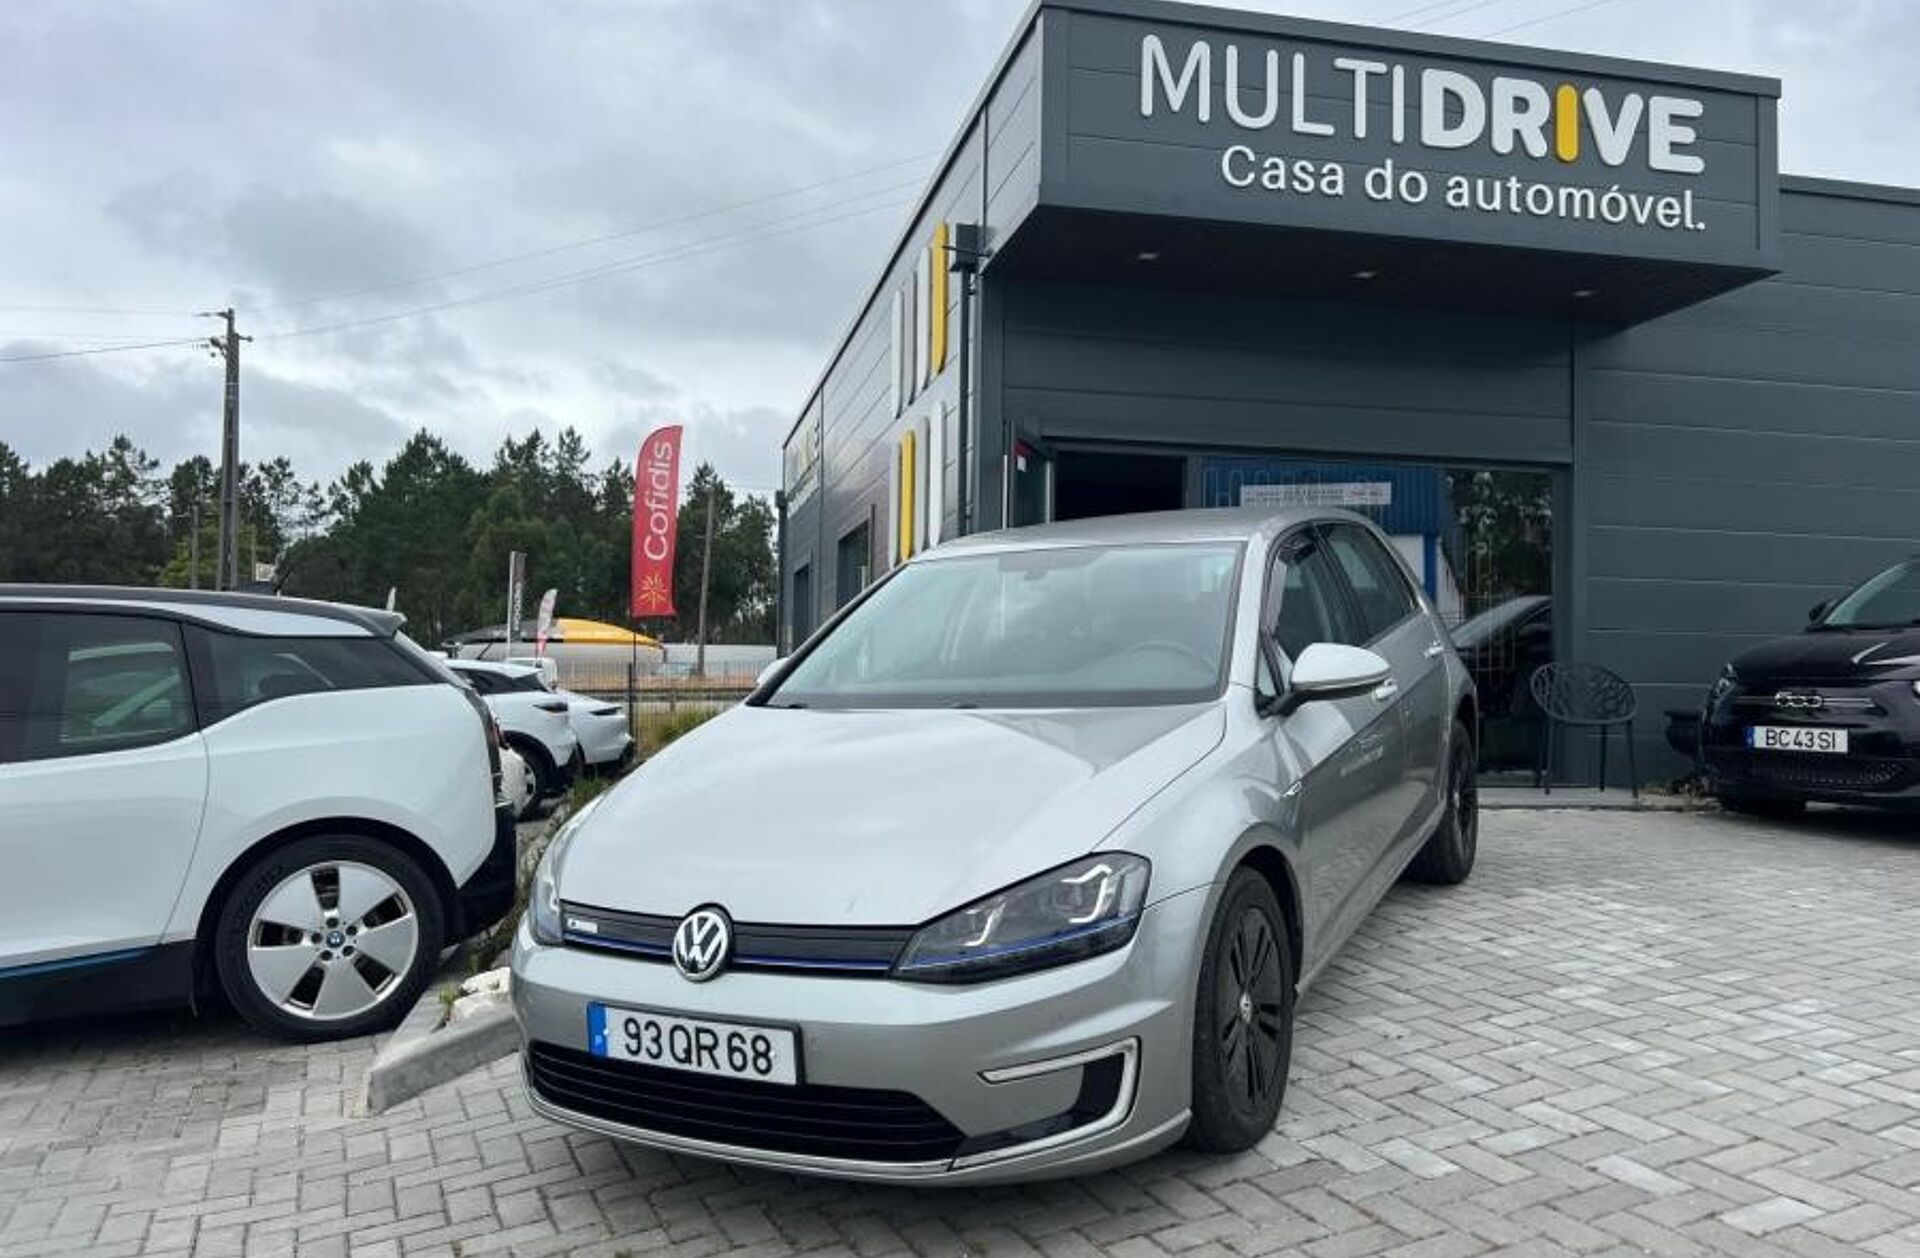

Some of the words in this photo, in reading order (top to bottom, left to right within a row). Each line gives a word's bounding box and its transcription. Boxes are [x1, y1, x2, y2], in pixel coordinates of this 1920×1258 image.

[1141, 34, 1705, 174] MULTIDRIVE
[1221, 144, 1345, 196] Casa
[1364, 158, 1429, 203] do
[1445, 175, 1706, 230] automóvel.
[643, 441, 673, 561] Cofidis
